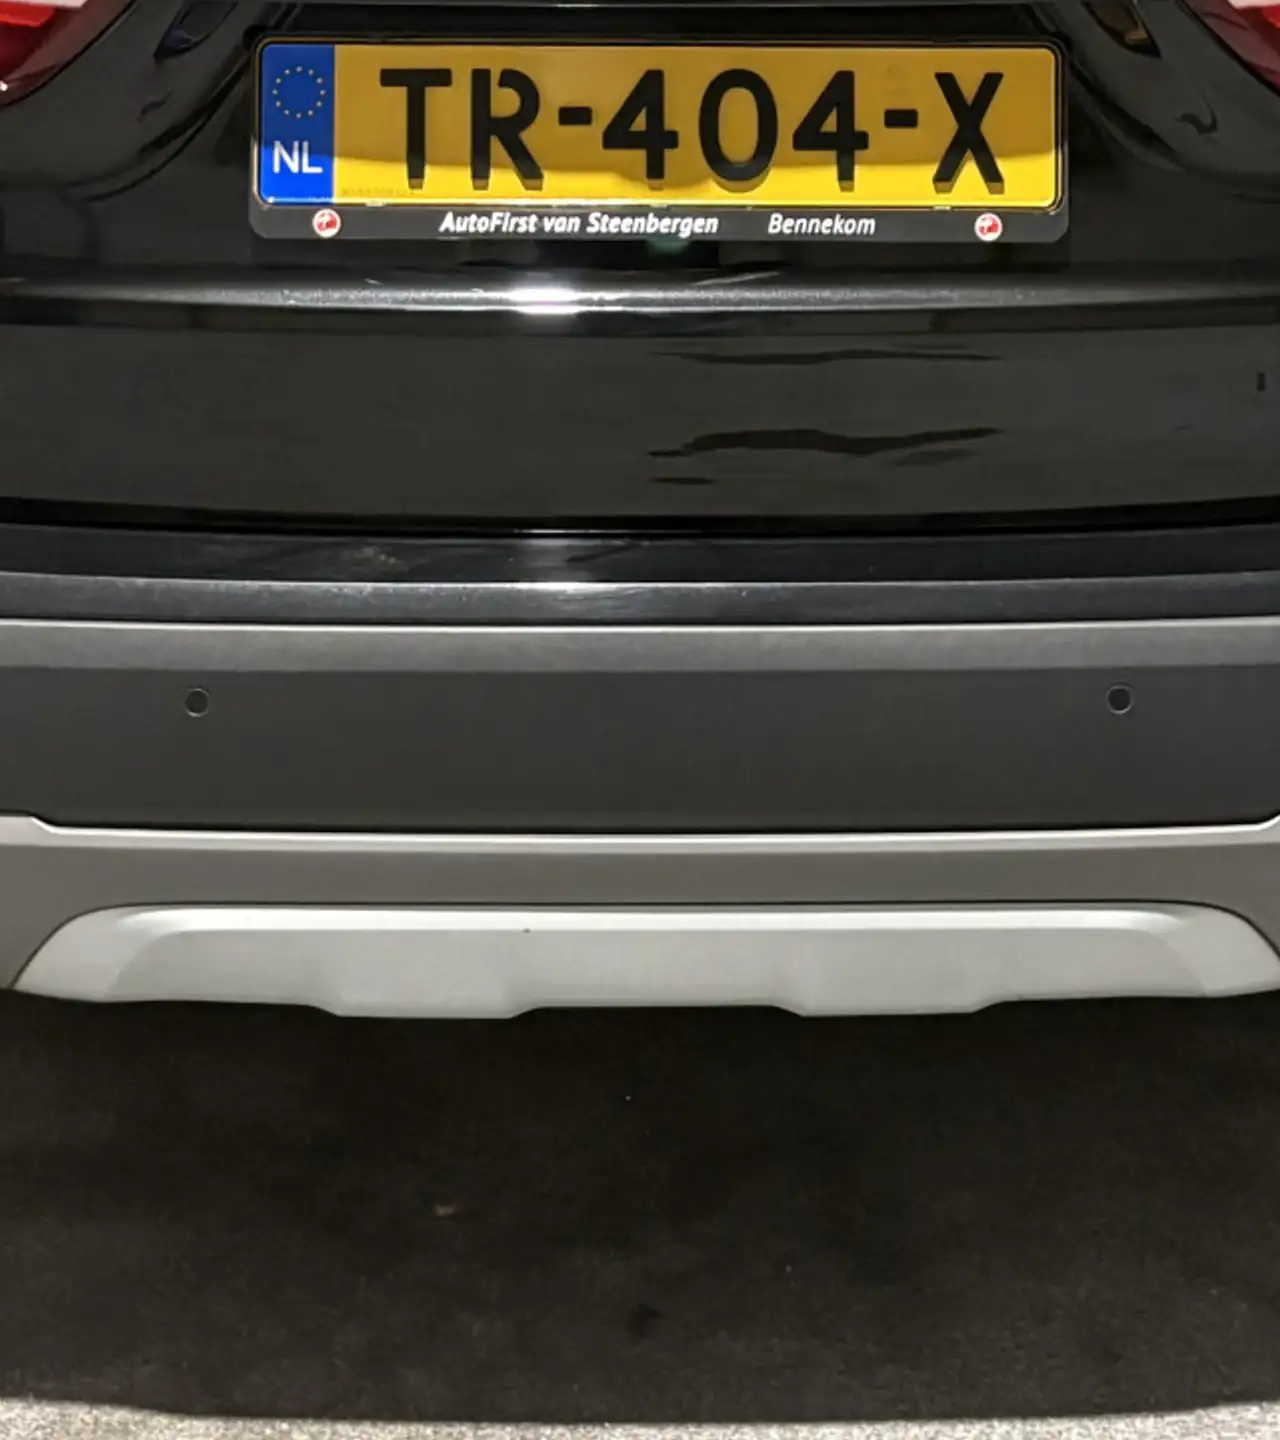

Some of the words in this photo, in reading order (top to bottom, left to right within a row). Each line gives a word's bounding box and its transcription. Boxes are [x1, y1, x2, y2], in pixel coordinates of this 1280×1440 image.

[380, 68, 1005, 193] TR-404-X
[272, 139, 324, 175] NL
[544, 216, 581, 233] van
[586, 211, 719, 238] Steenbergen
[768, 213, 876, 235] Bennekom
